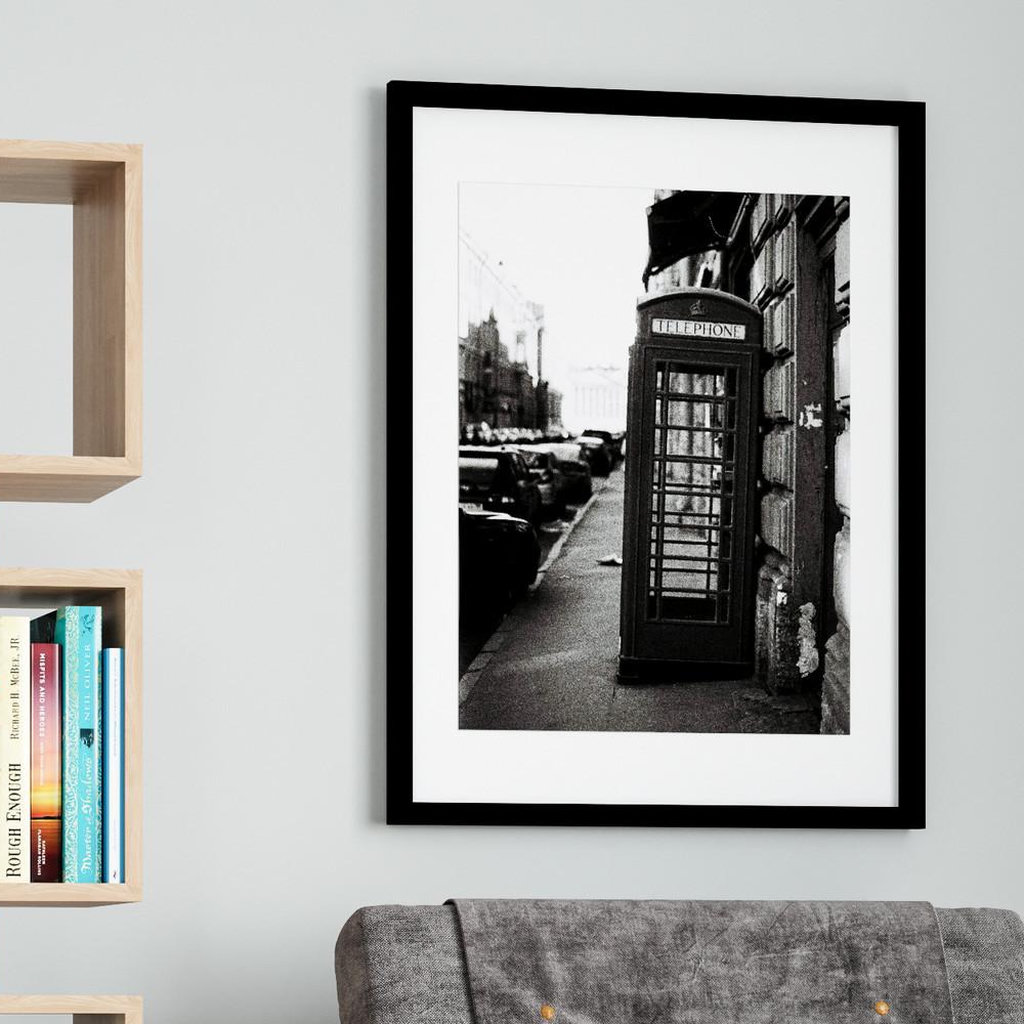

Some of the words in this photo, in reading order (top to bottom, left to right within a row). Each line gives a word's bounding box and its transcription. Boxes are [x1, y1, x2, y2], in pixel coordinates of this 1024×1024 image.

[657, 318, 743, 340] TELEPHONE
[10, 702, 20, 739] RICHARD
[6, 763, 21, 821] ENOUGH
[81, 757, 92, 814] Shadows
[6, 828, 21, 877] ROUGH
[81, 827, 92, 873] Master
